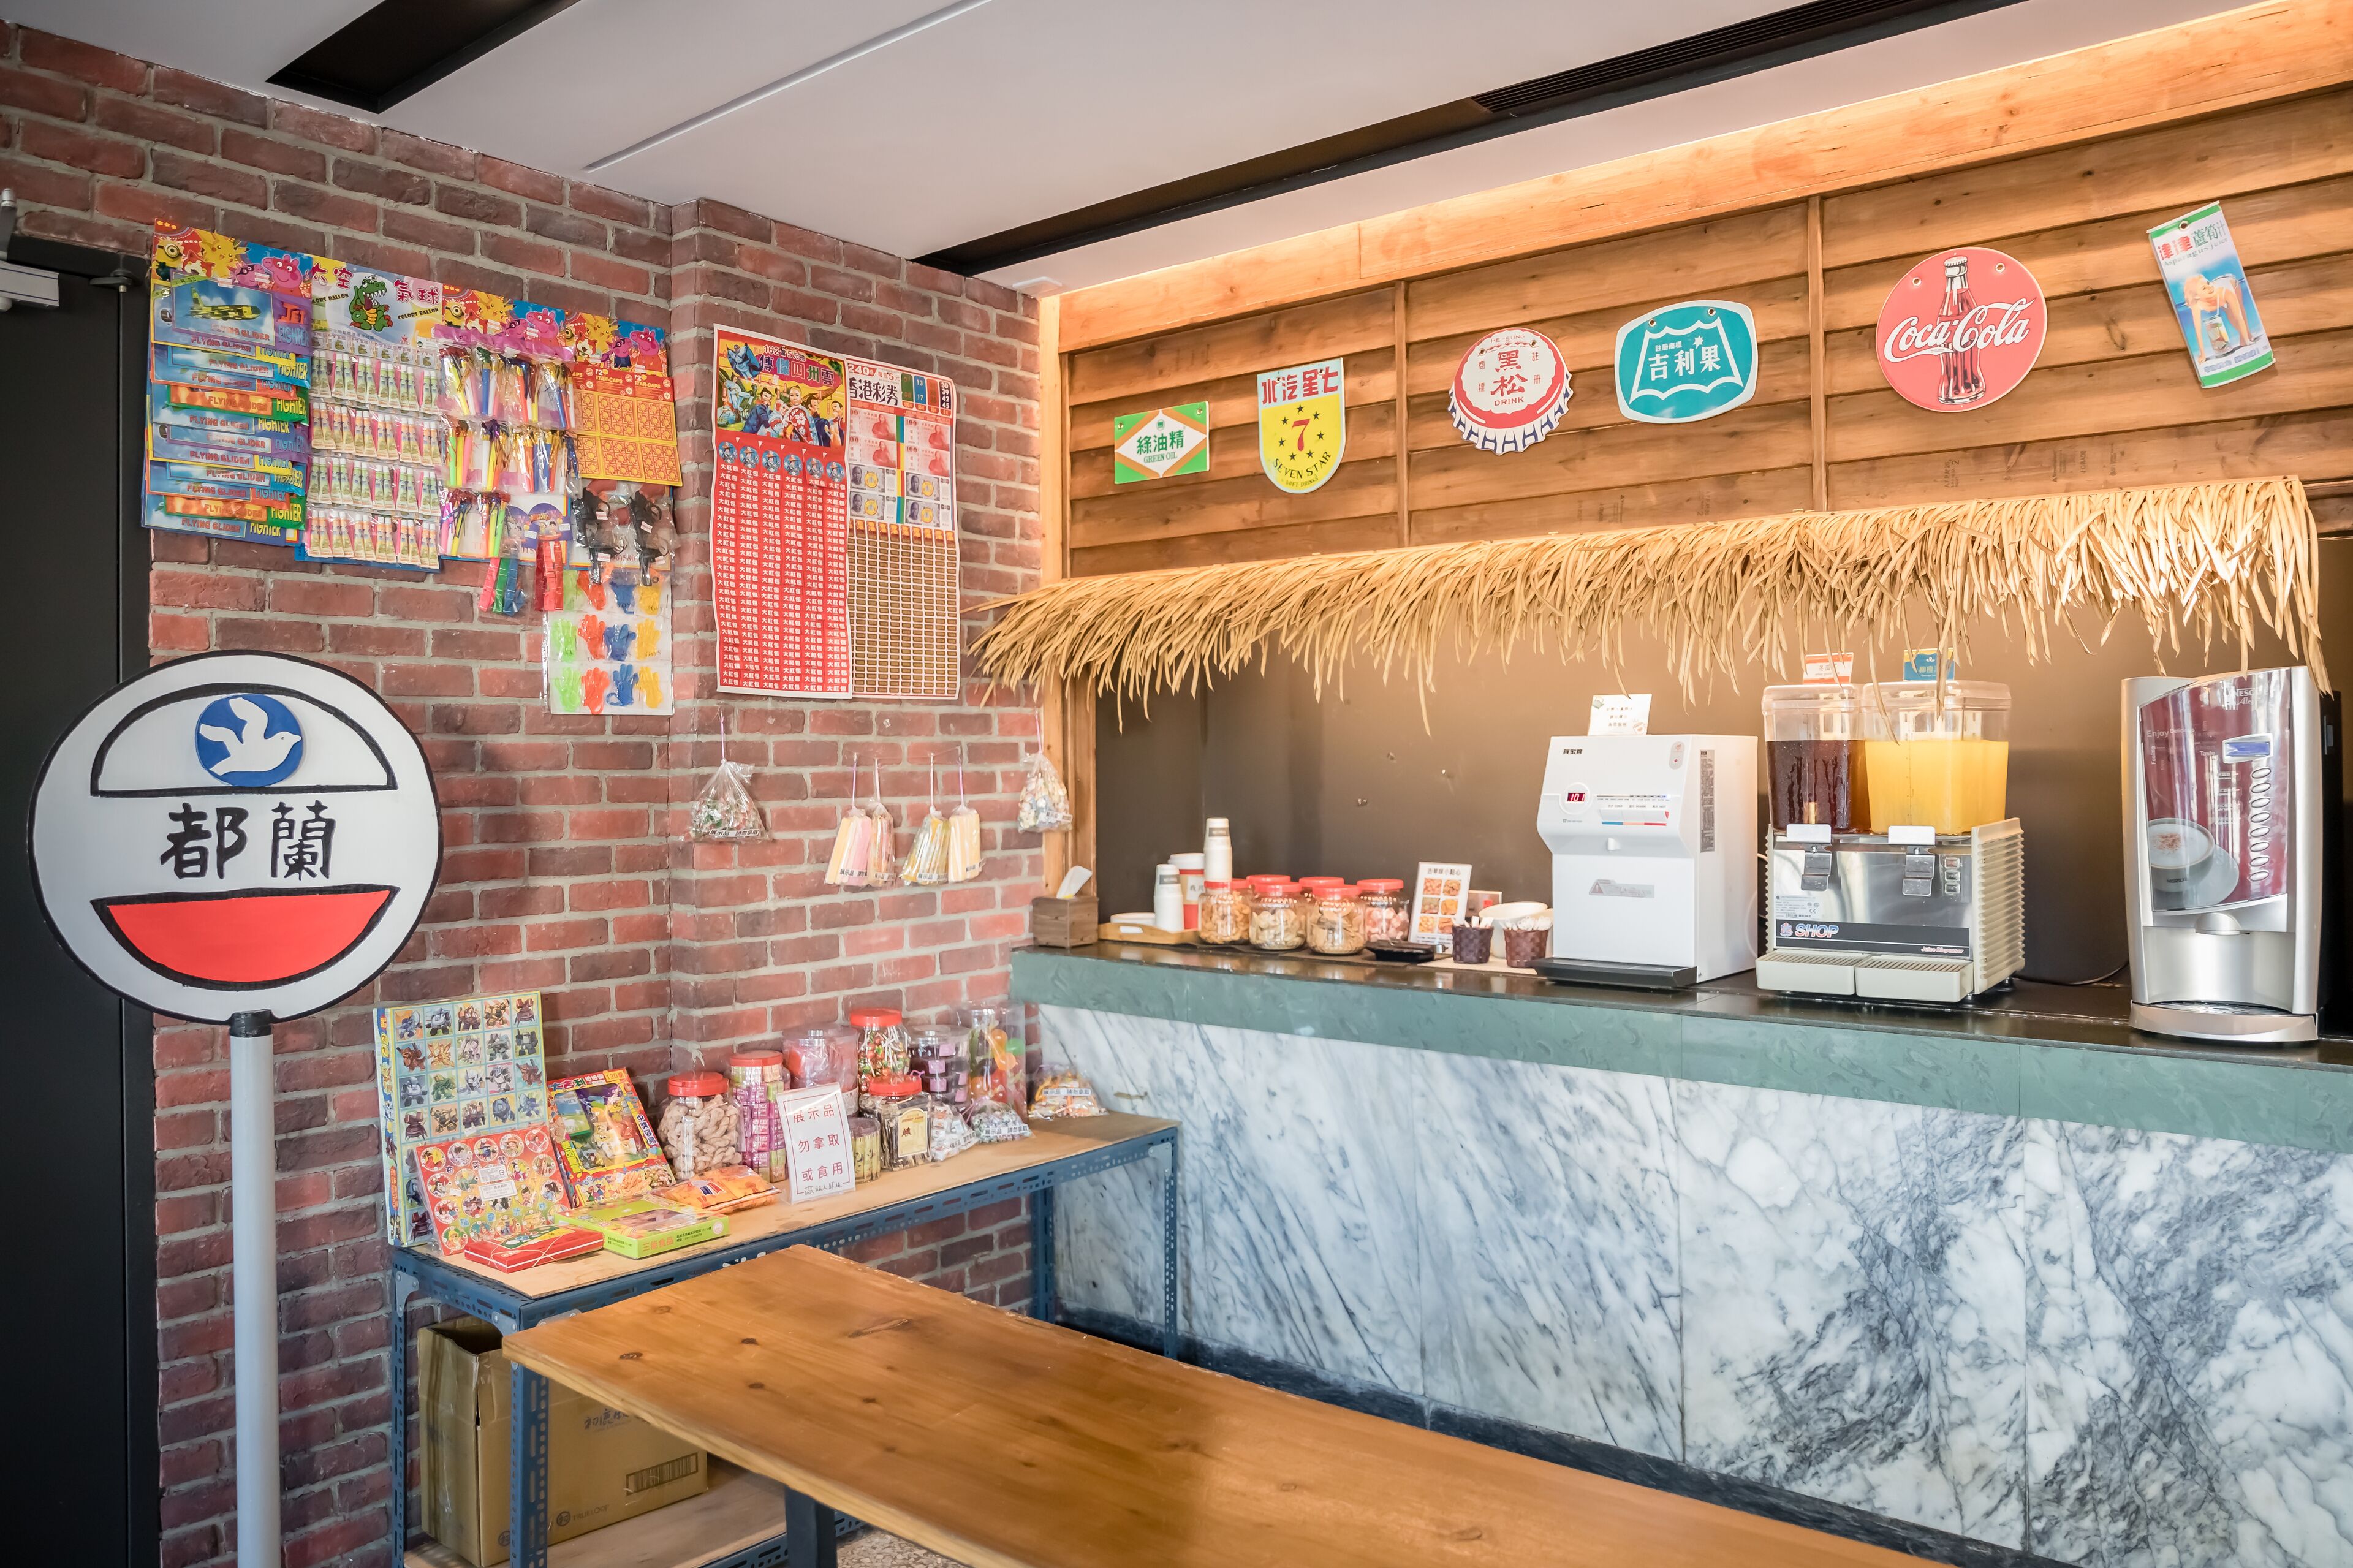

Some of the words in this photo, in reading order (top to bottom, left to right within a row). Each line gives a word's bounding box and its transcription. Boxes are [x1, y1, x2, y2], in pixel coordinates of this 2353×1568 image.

[398, 311, 418, 320] COLORS
[419, 307, 439, 316] BALLON
[241, 330, 270, 341] GLIDER
[278, 324, 309, 347] FIGHTER
[1884, 298, 2037, 363] Coca-Cola
[1490, 334, 1525, 343] HE-SUNG
[222, 341, 251, 352] GLIDER
[1648, 344, 1721, 381] 吉利果
[1490, 349, 1528, 397] 黑松
[849, 377, 898, 406] 香港彩券
[276, 398, 306, 416] FIGHTER
[1495, 396, 1525, 406] DRINK
[189, 415, 218, 426] FLYING
[220, 420, 249, 430] GLIDER
[1136, 430, 1184, 455] 綠油精
[1292, 419, 1311, 452] 7
[237, 438, 266, 449] GLIDER
[189, 450, 219, 461] FLYING
[221, 455, 250, 465] GLIDER
[1143, 454, 1165, 464] GREEN
[1166, 452, 1178, 461] OIL
[1273, 458, 1303, 479] SEVEN
[1306, 450, 1332, 477] STAR
[237, 473, 265, 482] GLIDER
[741, 469, 758, 478] 大紅包
[187, 485, 216, 494] FLYING
[1300, 476, 1319, 488] DRINKS
[181, 518, 211, 529] FLYING
[212, 523, 241, 532] GLIDER
[2146, 730, 2169, 738] Enjoy
[159, 799, 336, 881] 都蘭
[1795, 923, 1839, 939] SHOP
[549, 1078, 586, 1092] 大吉利
[794, 1104, 835, 1123] 展示品
[798, 1134, 840, 1153] 勿拿取
[802, 1162, 843, 1182] 或食用
